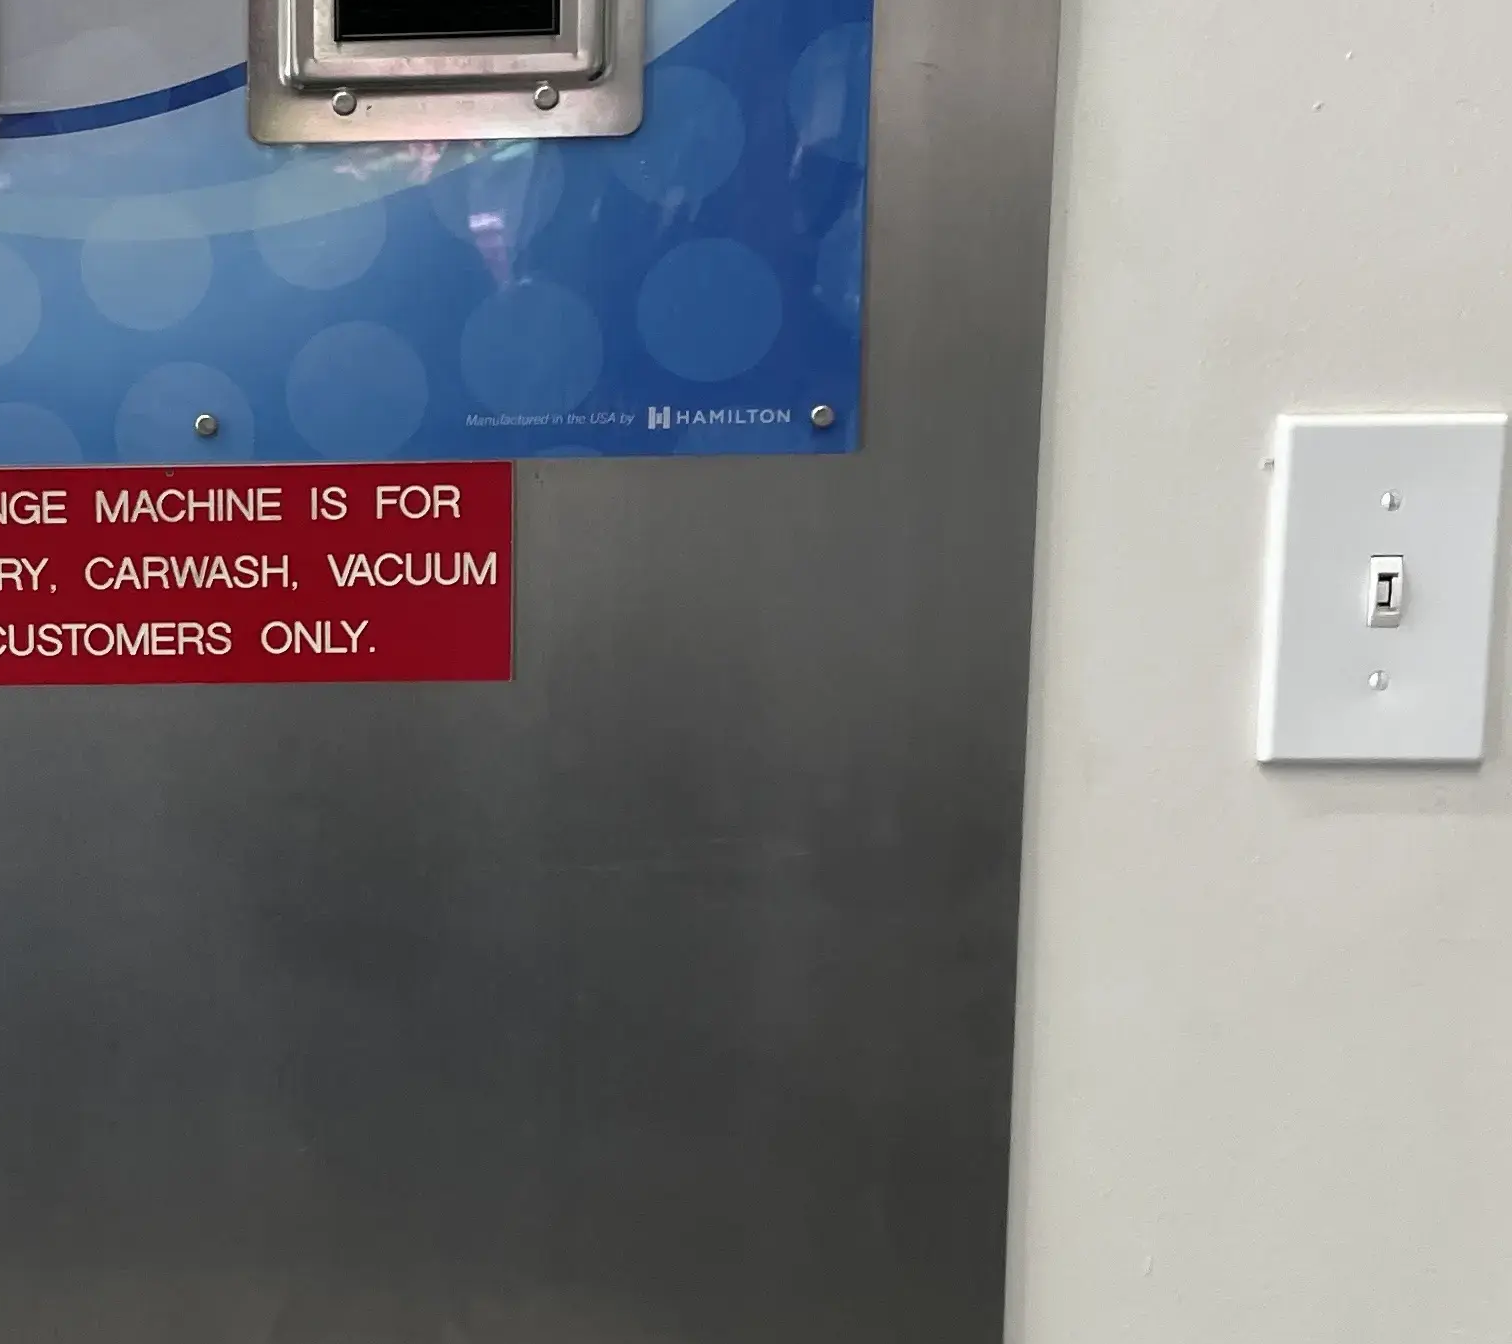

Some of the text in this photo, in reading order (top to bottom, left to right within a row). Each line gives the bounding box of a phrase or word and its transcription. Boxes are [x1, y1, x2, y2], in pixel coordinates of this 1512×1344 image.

[465, 411, 636, 428] Manufactured in the USA by
[676, 408, 792, 426] HAMILTON
[94, 486, 283, 524] MACHINE
[310, 485, 348, 522] IS
[375, 484, 461, 521] FOR
[84, 553, 299, 592] CARWASH,
[326, 551, 498, 587] VACUUM
[259, 619, 377, 656] ONLY.
